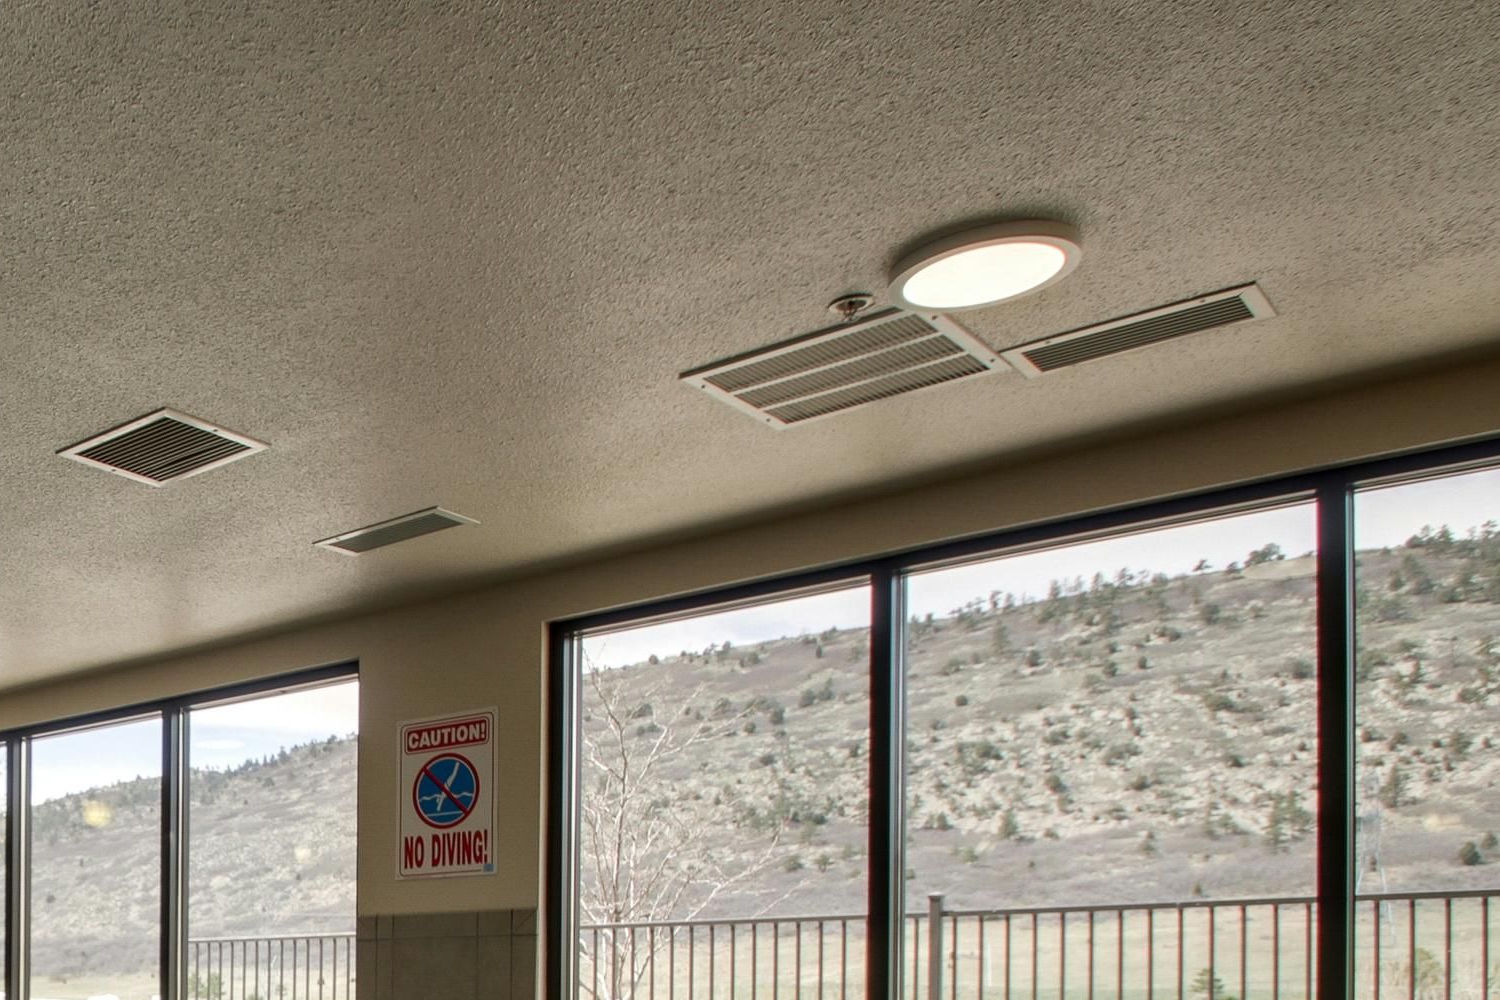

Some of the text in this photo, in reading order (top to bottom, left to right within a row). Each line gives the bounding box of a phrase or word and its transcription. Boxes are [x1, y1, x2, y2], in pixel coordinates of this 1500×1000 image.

[408, 723, 486, 749] CAUTION!
[404, 829, 488, 869] NO DIVING!
